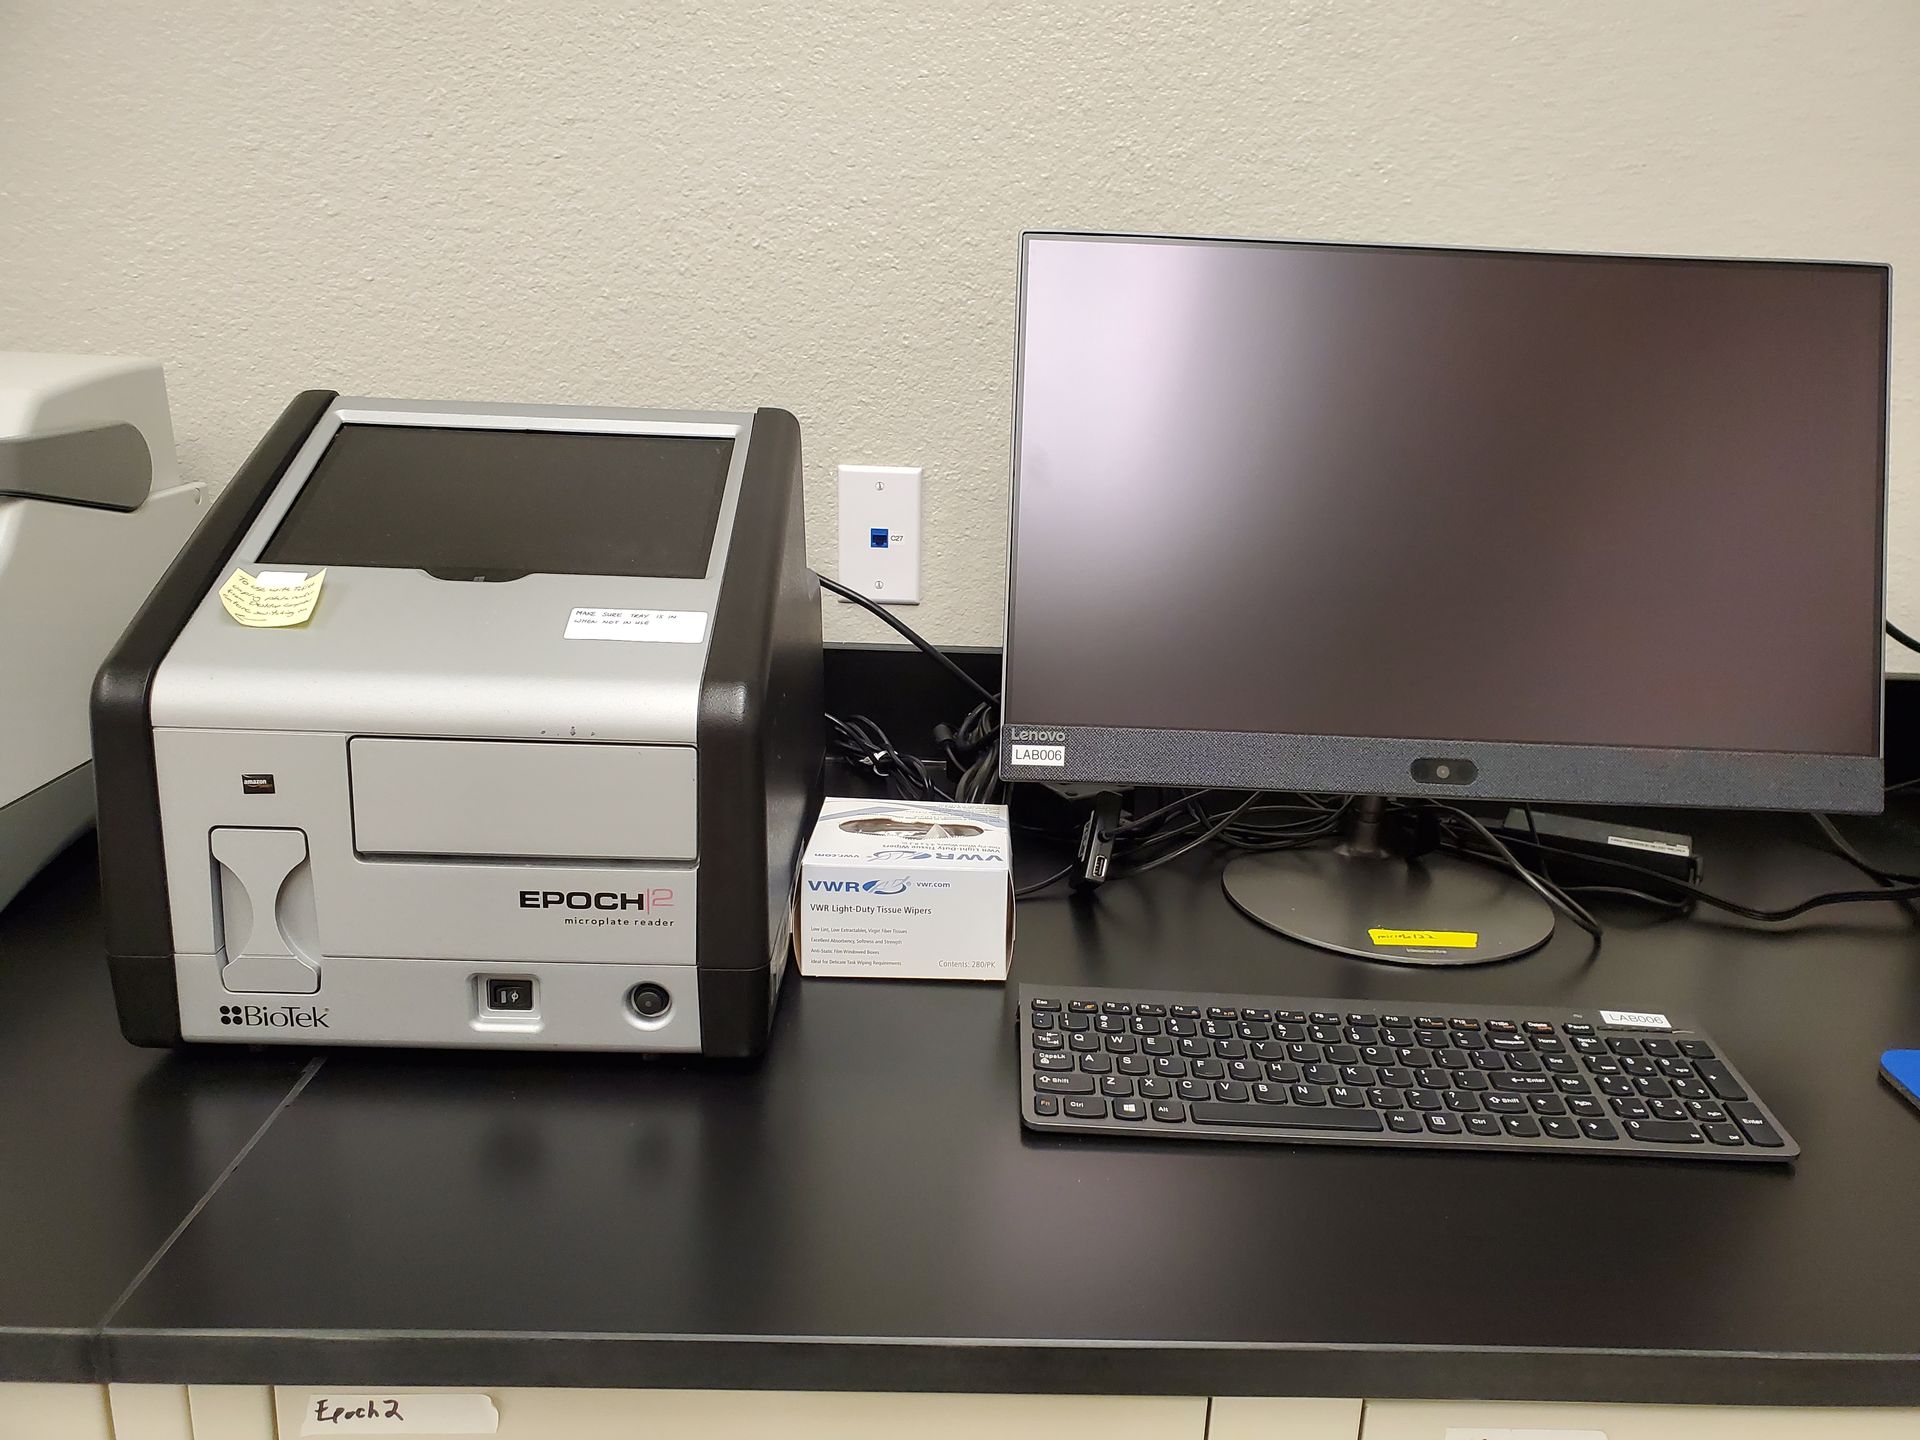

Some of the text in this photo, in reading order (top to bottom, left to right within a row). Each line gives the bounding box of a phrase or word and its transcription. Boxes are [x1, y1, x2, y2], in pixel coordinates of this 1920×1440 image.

[1011, 727, 1066, 742] Lenovo
[1015, 748, 1062, 761] LAB006
[935, 852, 1004, 862] VWR
[808, 880, 860, 892] VWR
[519, 888, 675, 910] EPOCH 2
[810, 903, 932, 916] VWR Light-Duty Tissue Wipers
[564, 917, 674, 928] microplate reader
[938, 960, 970, 968] Contents:
[244, 1005, 330, 1028] BioTek
[1610, 1014, 1664, 1024] LAB006
[1074, 1033, 1084, 1041] Q
[1110, 1035, 1123, 1044] W
[1183, 1039, 1193, 1047] R
[1220, 1041, 1229, 1049] T
[1256, 1042, 1265, 1050] Y
[1366, 1047, 1377, 1055] O
[1085, 1054, 1094, 1062] A
[1122, 1056, 1132, 1064] S
[1159, 1058, 1169, 1066] D
[1234, 1062, 1245, 1070] G
[1271, 1063, 1282, 1071] H
[1346, 1067, 1357, 1075] K
[1384, 1068, 1394, 1077] L
[1106, 1077, 1116, 1085] Z
[1144, 1079, 1154, 1087] X
[1182, 1081, 1192, 1089] C
[1220, 1082, 1230, 1090] V
[1258, 1084, 1268, 1092] B
[1297, 1086, 1308, 1094] N
[1335, 1088, 1348, 1096] M
[1654, 1100, 1664, 1108] 2
[1630, 1121, 1639, 1129] 0
[314, 1398, 404, 1424] Epoch 2
